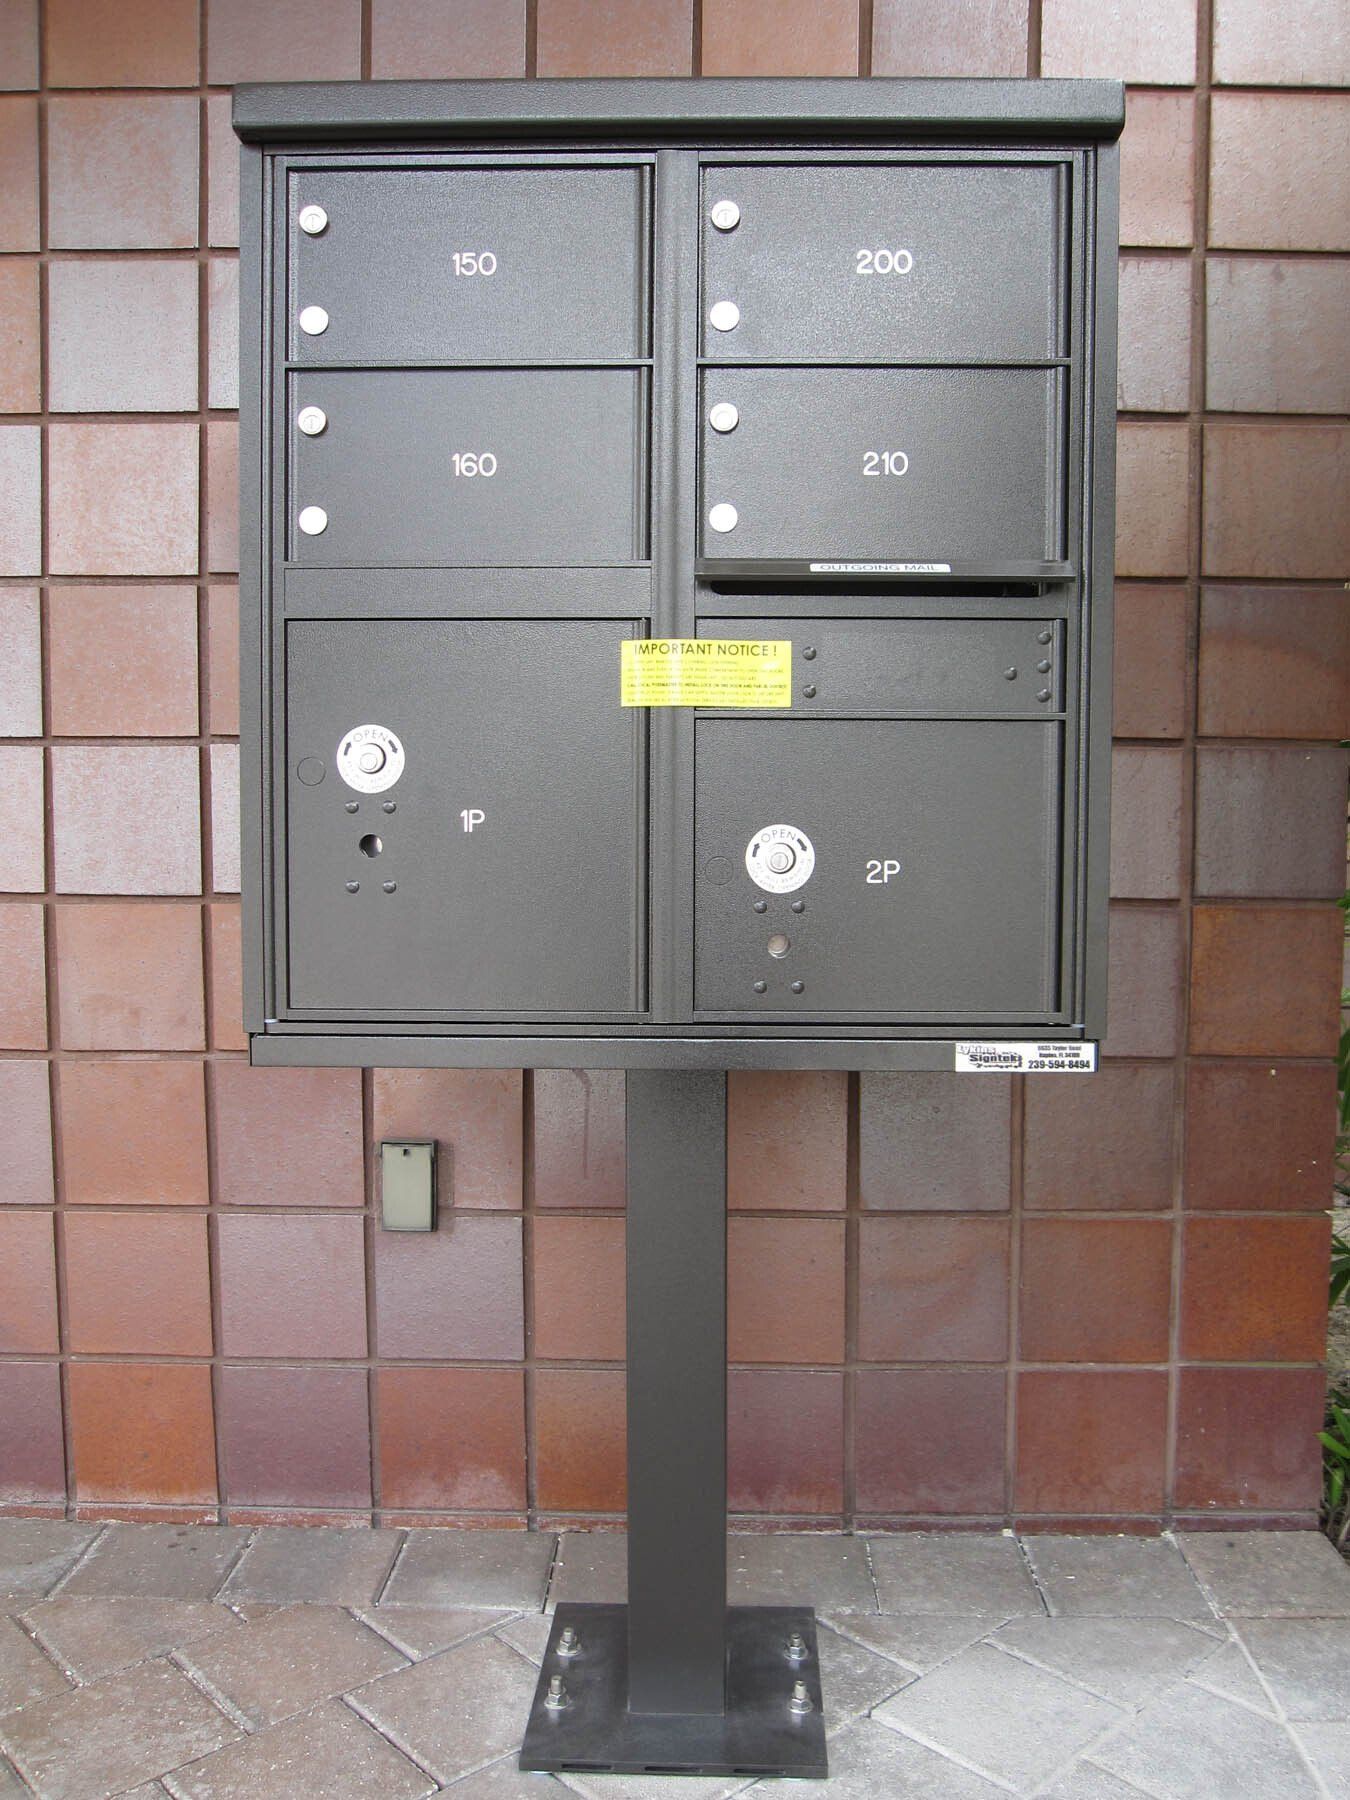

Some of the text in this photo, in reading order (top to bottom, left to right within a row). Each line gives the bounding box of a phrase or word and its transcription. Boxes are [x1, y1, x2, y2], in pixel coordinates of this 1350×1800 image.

[452, 252, 497, 276] 150
[856, 249, 913, 274] 200
[451, 452, 497, 477] 160
[863, 451, 909, 476] 210
[634, 643, 712, 655] IMPORTANT
[717, 644, 769, 656] NOTICE
[353, 729, 388, 742] OPEN
[460, 809, 486, 833] 1P
[761, 829, 796, 843] OPEN
[866, 860, 901, 884] 2P
[1028, 1060, 1090, 1069] 239-594-8494
